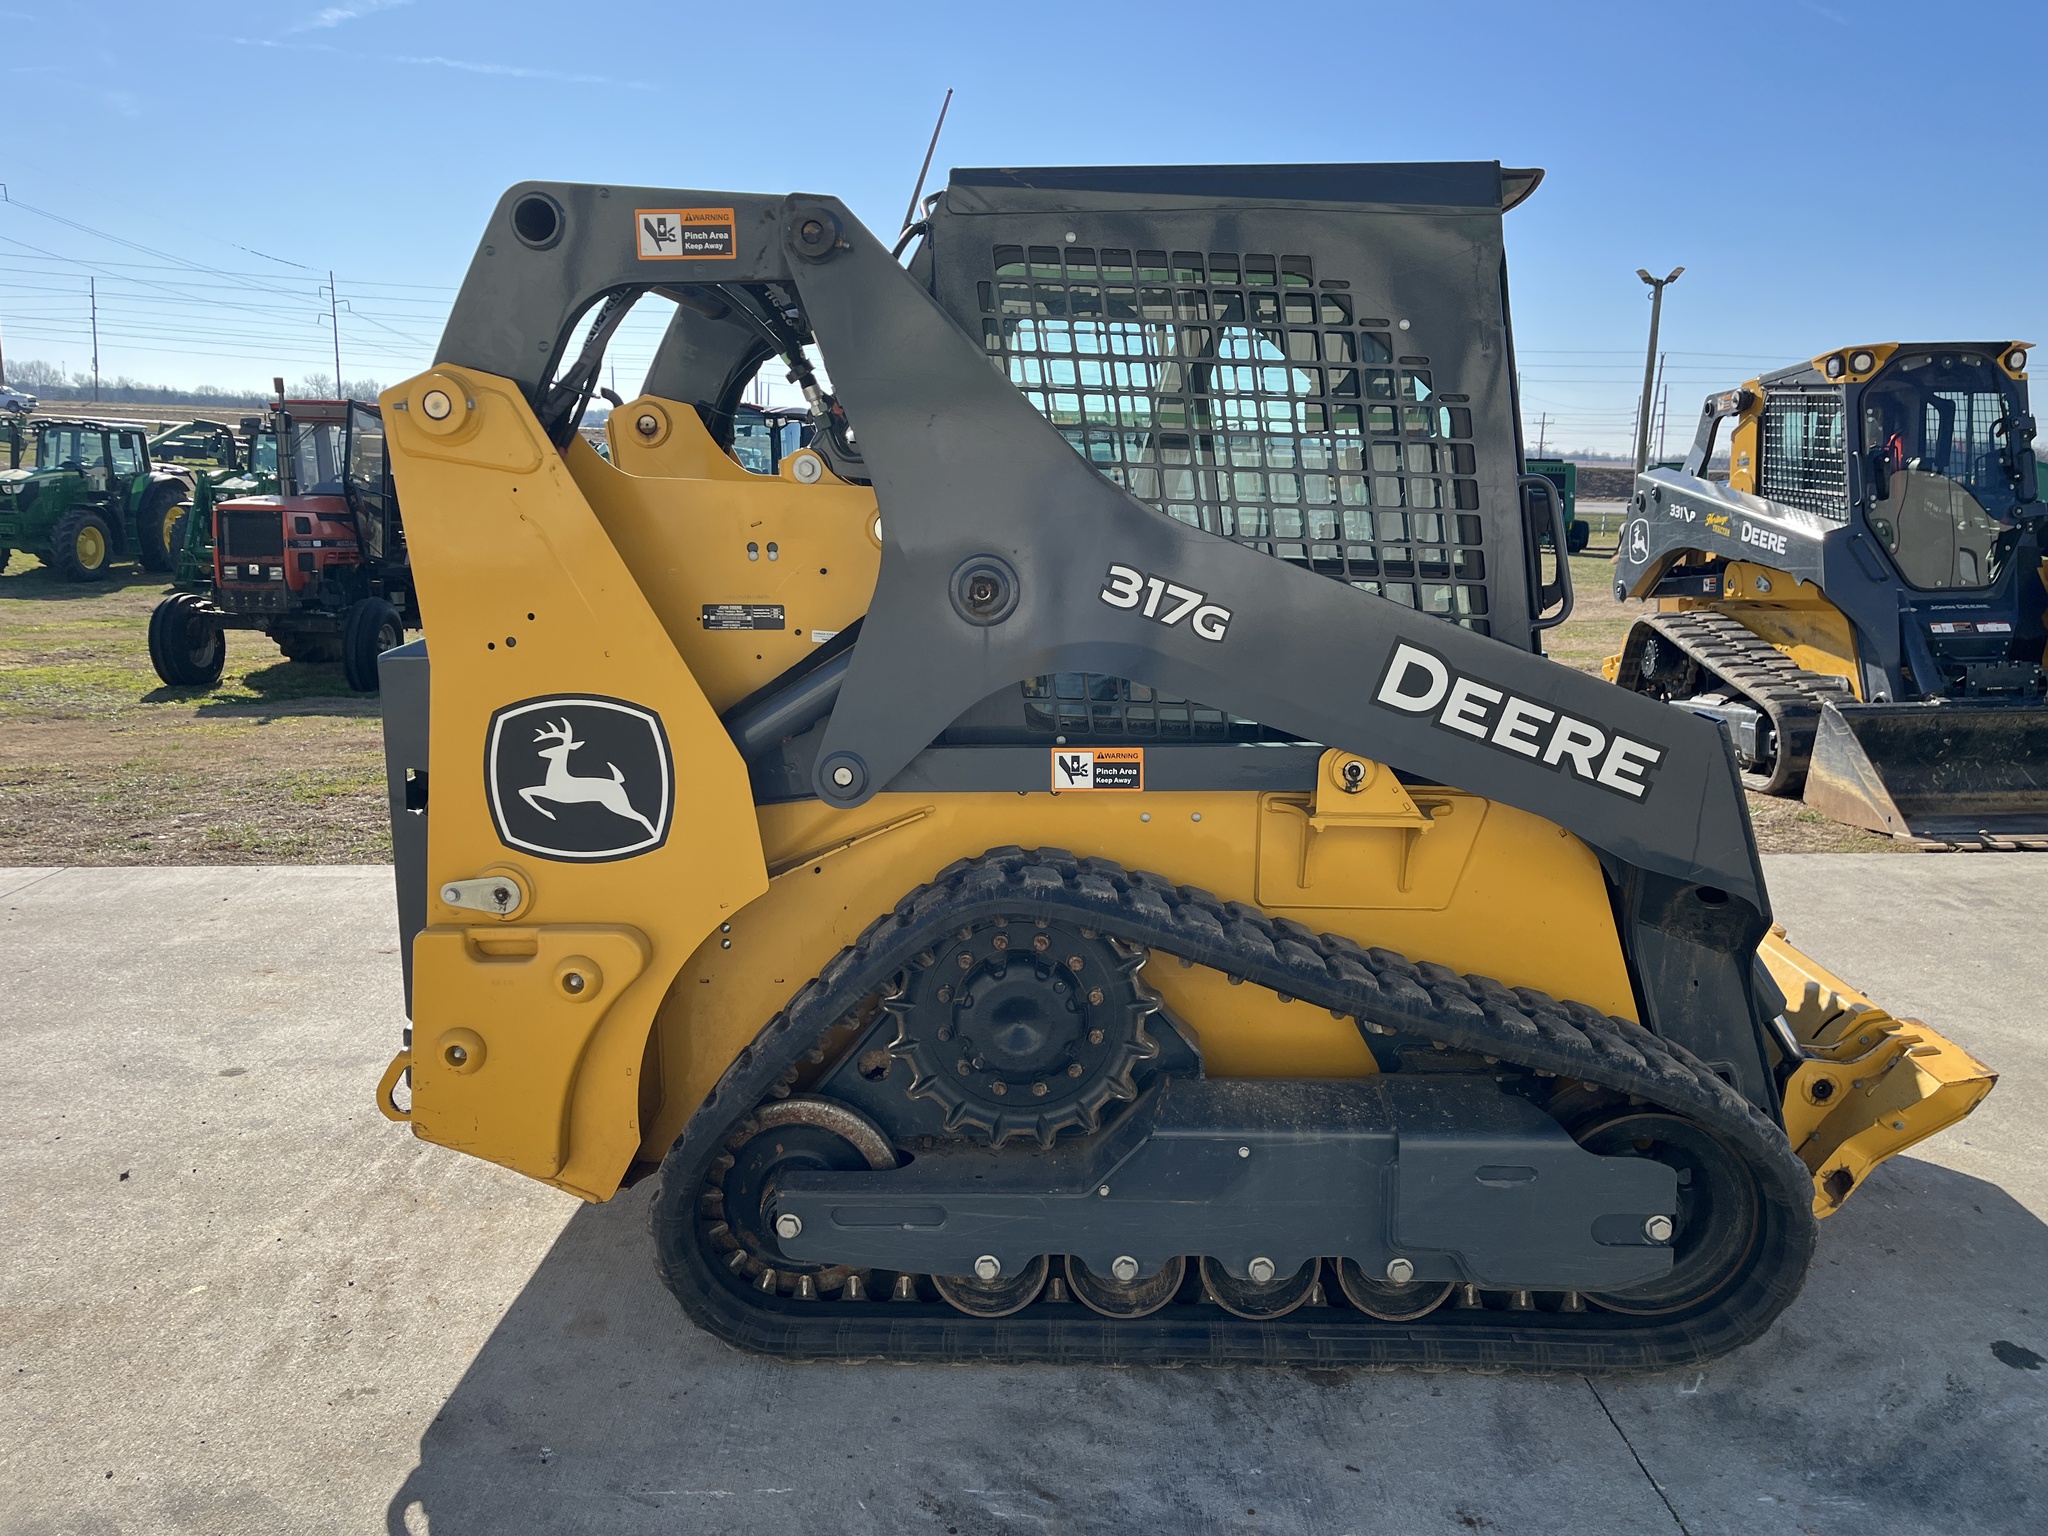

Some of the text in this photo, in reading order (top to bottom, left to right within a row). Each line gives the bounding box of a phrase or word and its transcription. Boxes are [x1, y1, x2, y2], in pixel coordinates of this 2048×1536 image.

[692, 213, 730, 221] WARNING
[684, 231, 729, 240] Pinch Area
[684, 242, 724, 251] Keep Away
[1740, 520, 1788, 556] DEERE
[1101, 565, 1231, 641] 317G
[1377, 643, 1661, 798] DEERE
[1096, 767, 1137, 775] Pinch Area
[1096, 777, 1132, 785] Keep Away
